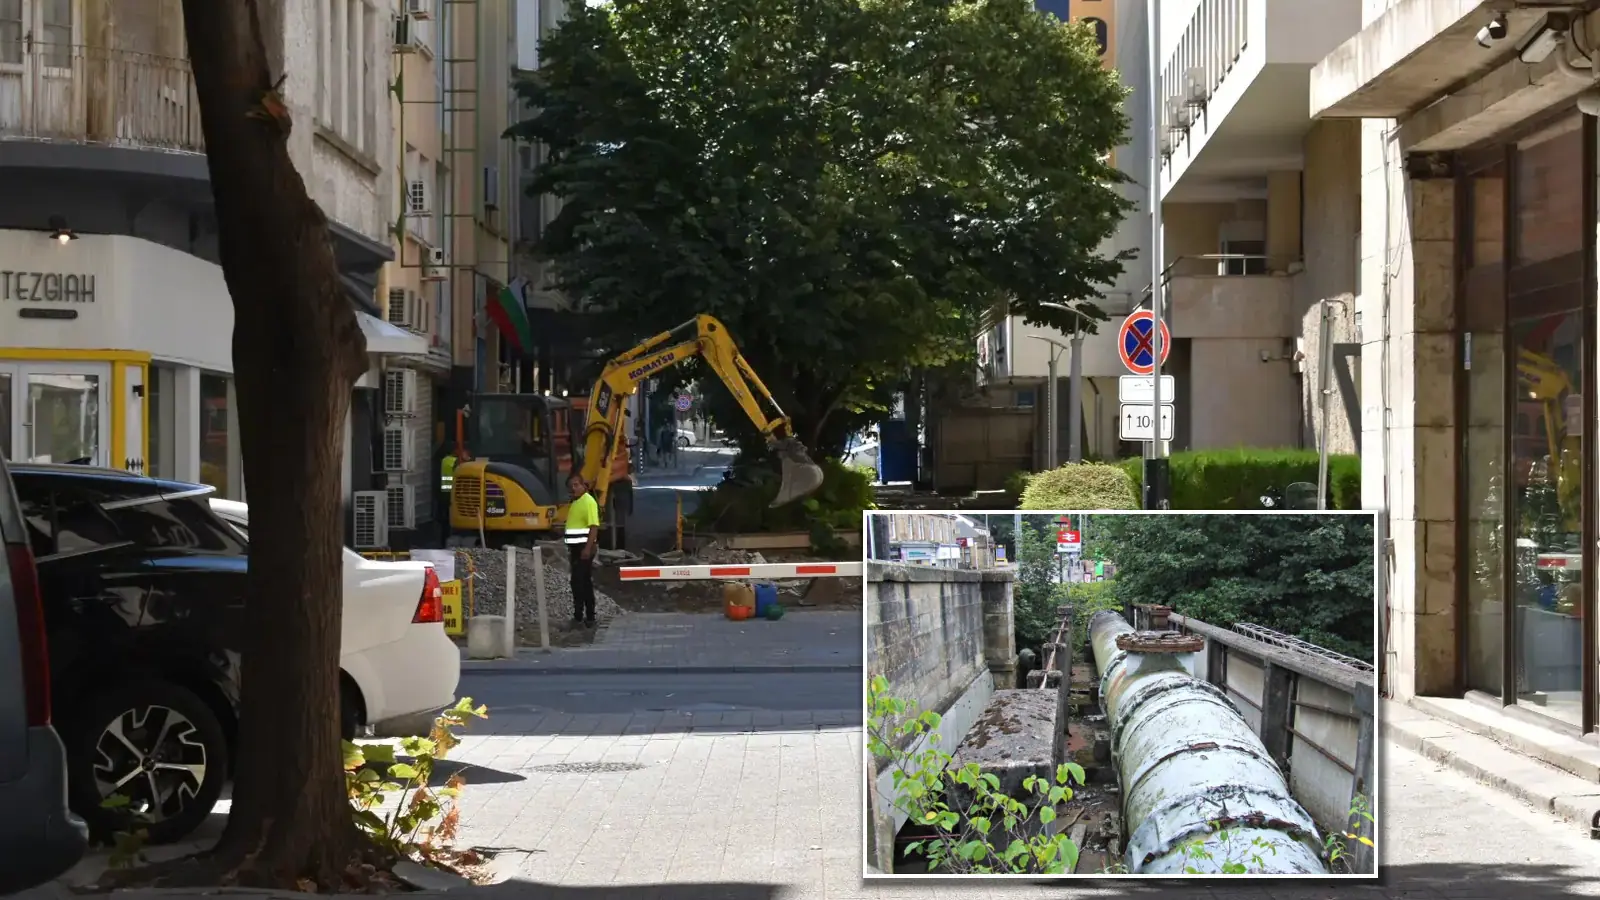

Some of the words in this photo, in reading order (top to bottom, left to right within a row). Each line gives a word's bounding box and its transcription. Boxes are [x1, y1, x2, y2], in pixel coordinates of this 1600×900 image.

[1, 270, 95, 302] TEZGIAH
[629, 353, 674, 379] KOMATSU
[1136, 415, 1154, 428] 10
